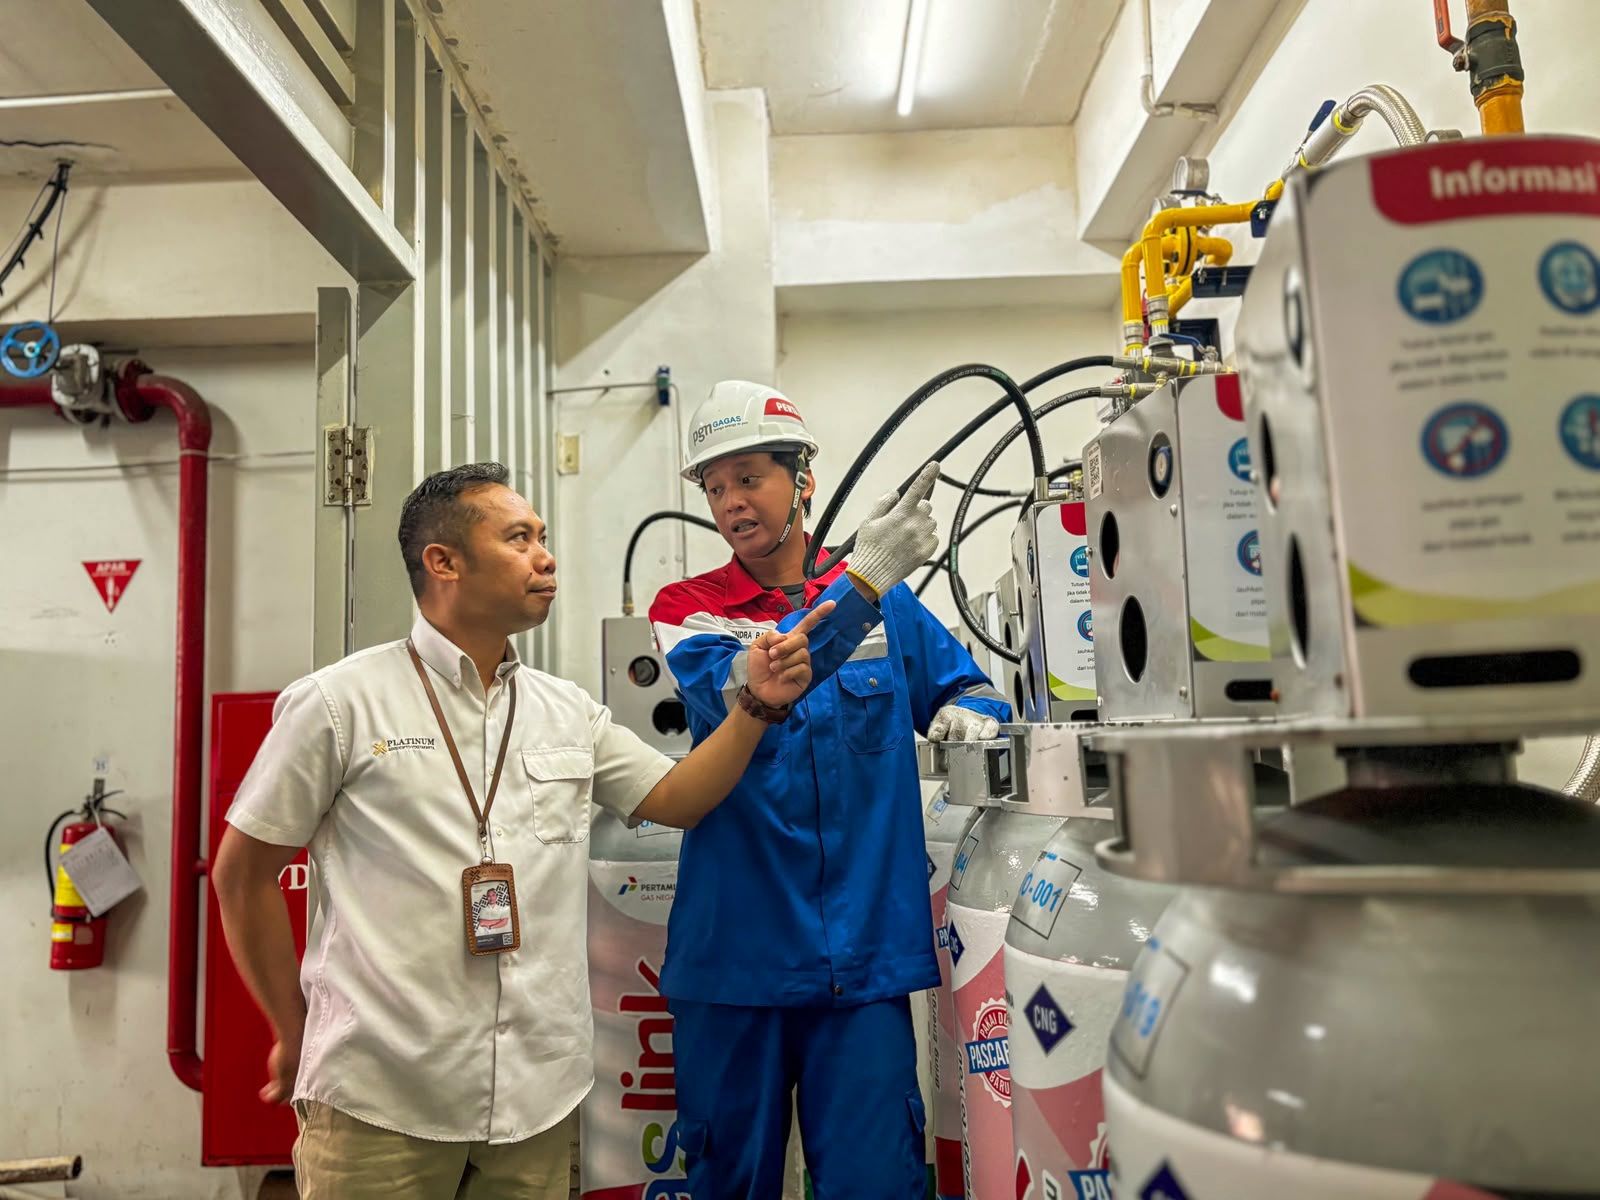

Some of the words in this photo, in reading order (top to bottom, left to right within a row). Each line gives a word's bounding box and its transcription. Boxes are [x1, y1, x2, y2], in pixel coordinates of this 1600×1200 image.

[1429, 159, 1597, 200] Informasi
[712, 415, 742, 428] GAGAS
[692, 422, 713, 446] pgn
[96, 562, 127, 572] APAR
[732, 631, 752, 639] NDRA
[387, 738, 435, 747] PLATINUM
[980, 1012, 998, 1038] PAKAI
[1033, 1003, 1058, 1034] CNG
[989, 1071, 1011, 1095] BARU
